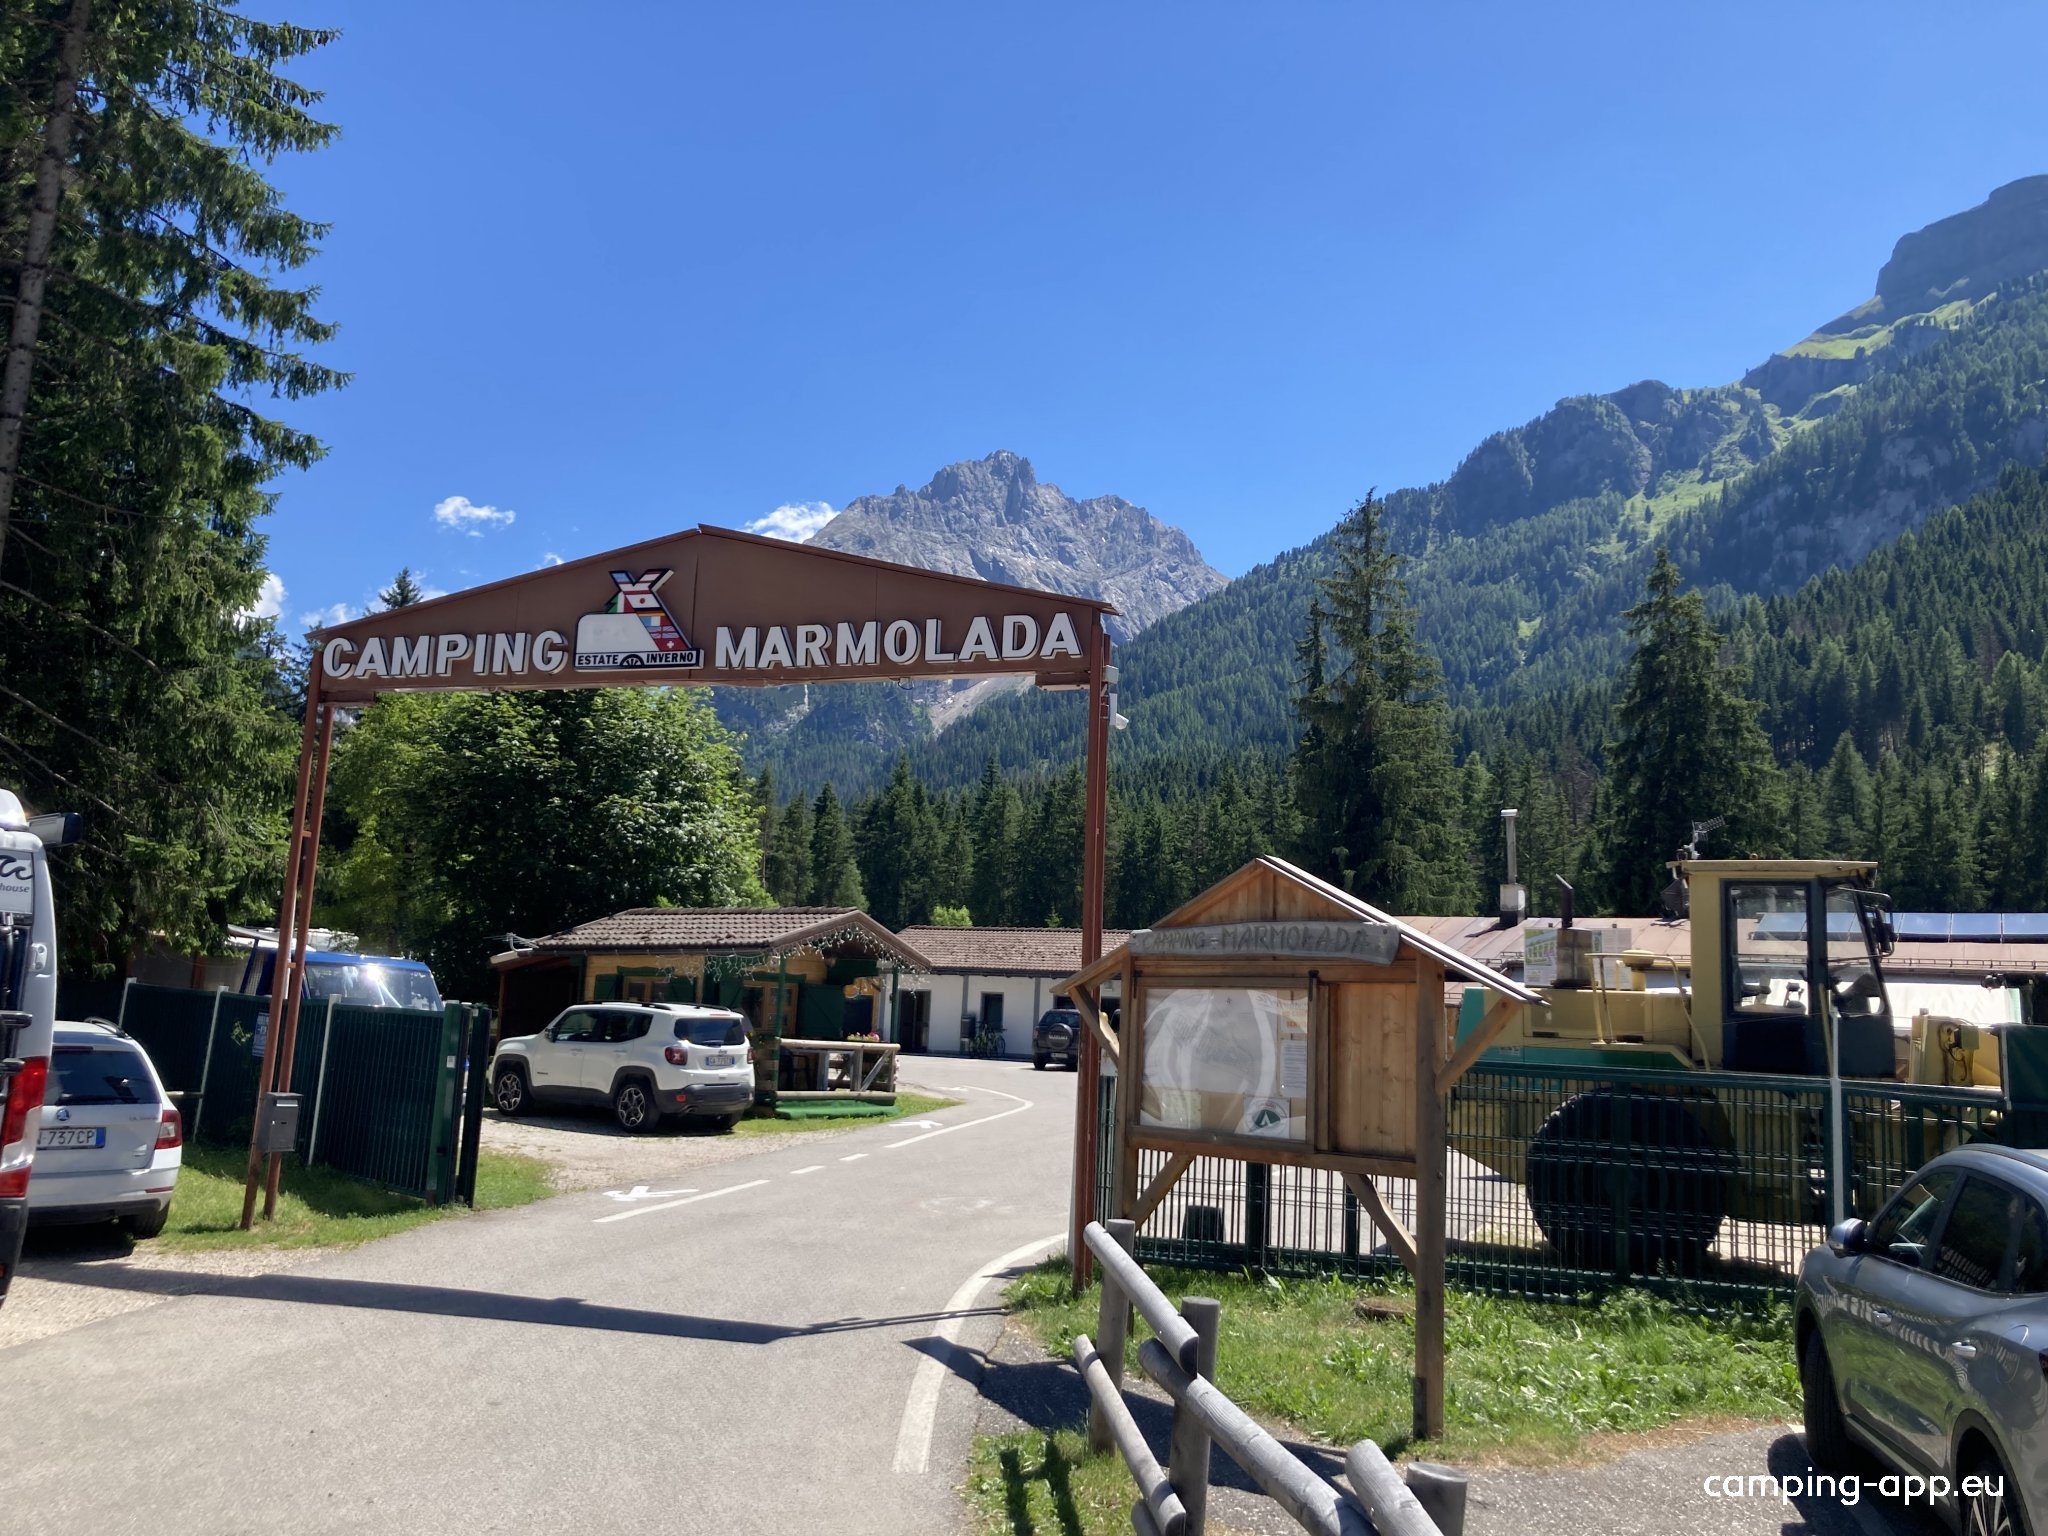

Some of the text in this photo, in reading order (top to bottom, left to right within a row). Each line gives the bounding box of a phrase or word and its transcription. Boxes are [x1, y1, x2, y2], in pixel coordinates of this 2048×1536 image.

[322, 612, 1083, 680] CAMPING MARMOLADA
[577, 652, 694, 665] ESTATE INVERNO
[1143, 924, 1369, 953] CAMPING MARMOLADA
